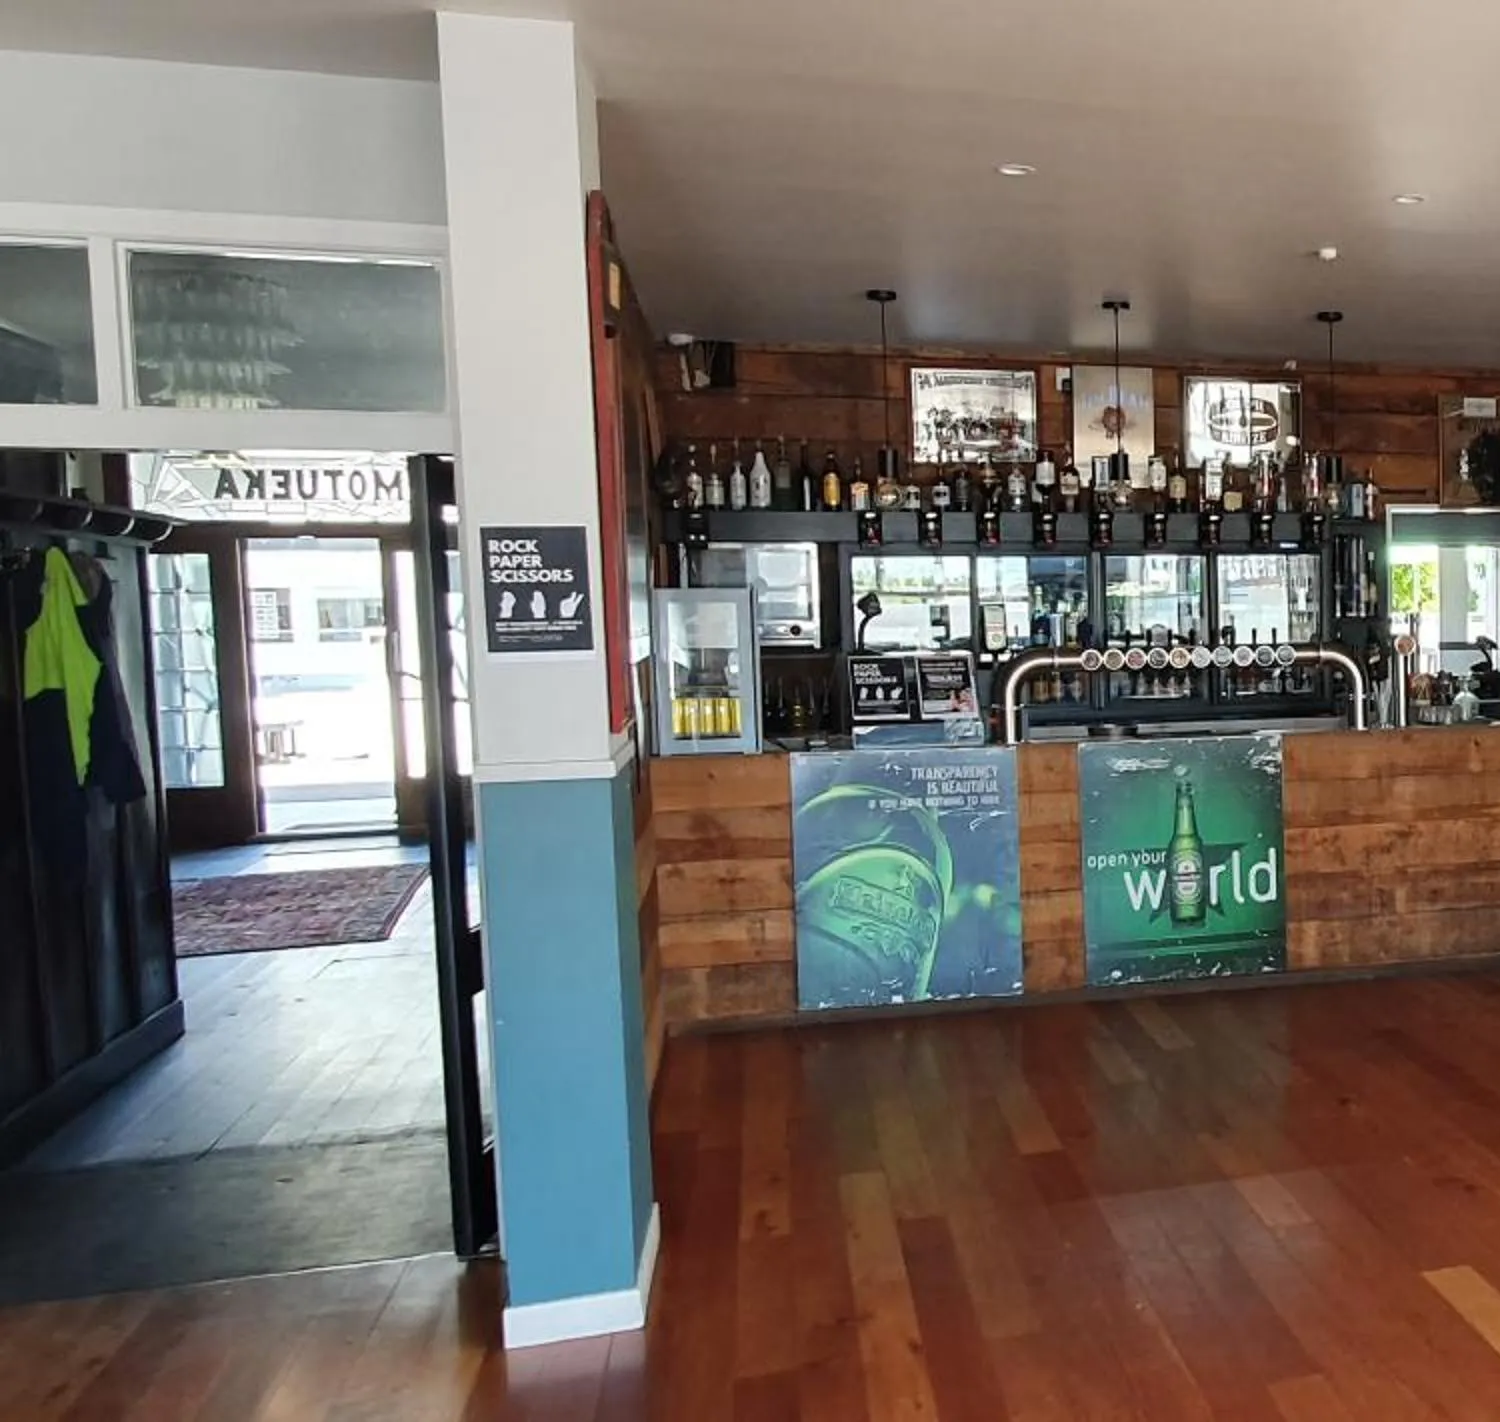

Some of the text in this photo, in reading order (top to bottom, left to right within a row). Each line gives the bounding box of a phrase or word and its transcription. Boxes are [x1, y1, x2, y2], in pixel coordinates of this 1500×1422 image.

[487, 539, 539, 553] ROCK
[489, 554, 543, 568] PAPER
[490, 569, 574, 583] SCISSORS
[910, 765, 999, 781] TRANSPARENCY
[926, 779, 999, 795] IS BEAUTIFUL
[967, 795, 979, 806] TO
[1087, 849, 1167, 871] open your
[1123, 847, 1278, 912] wrld
